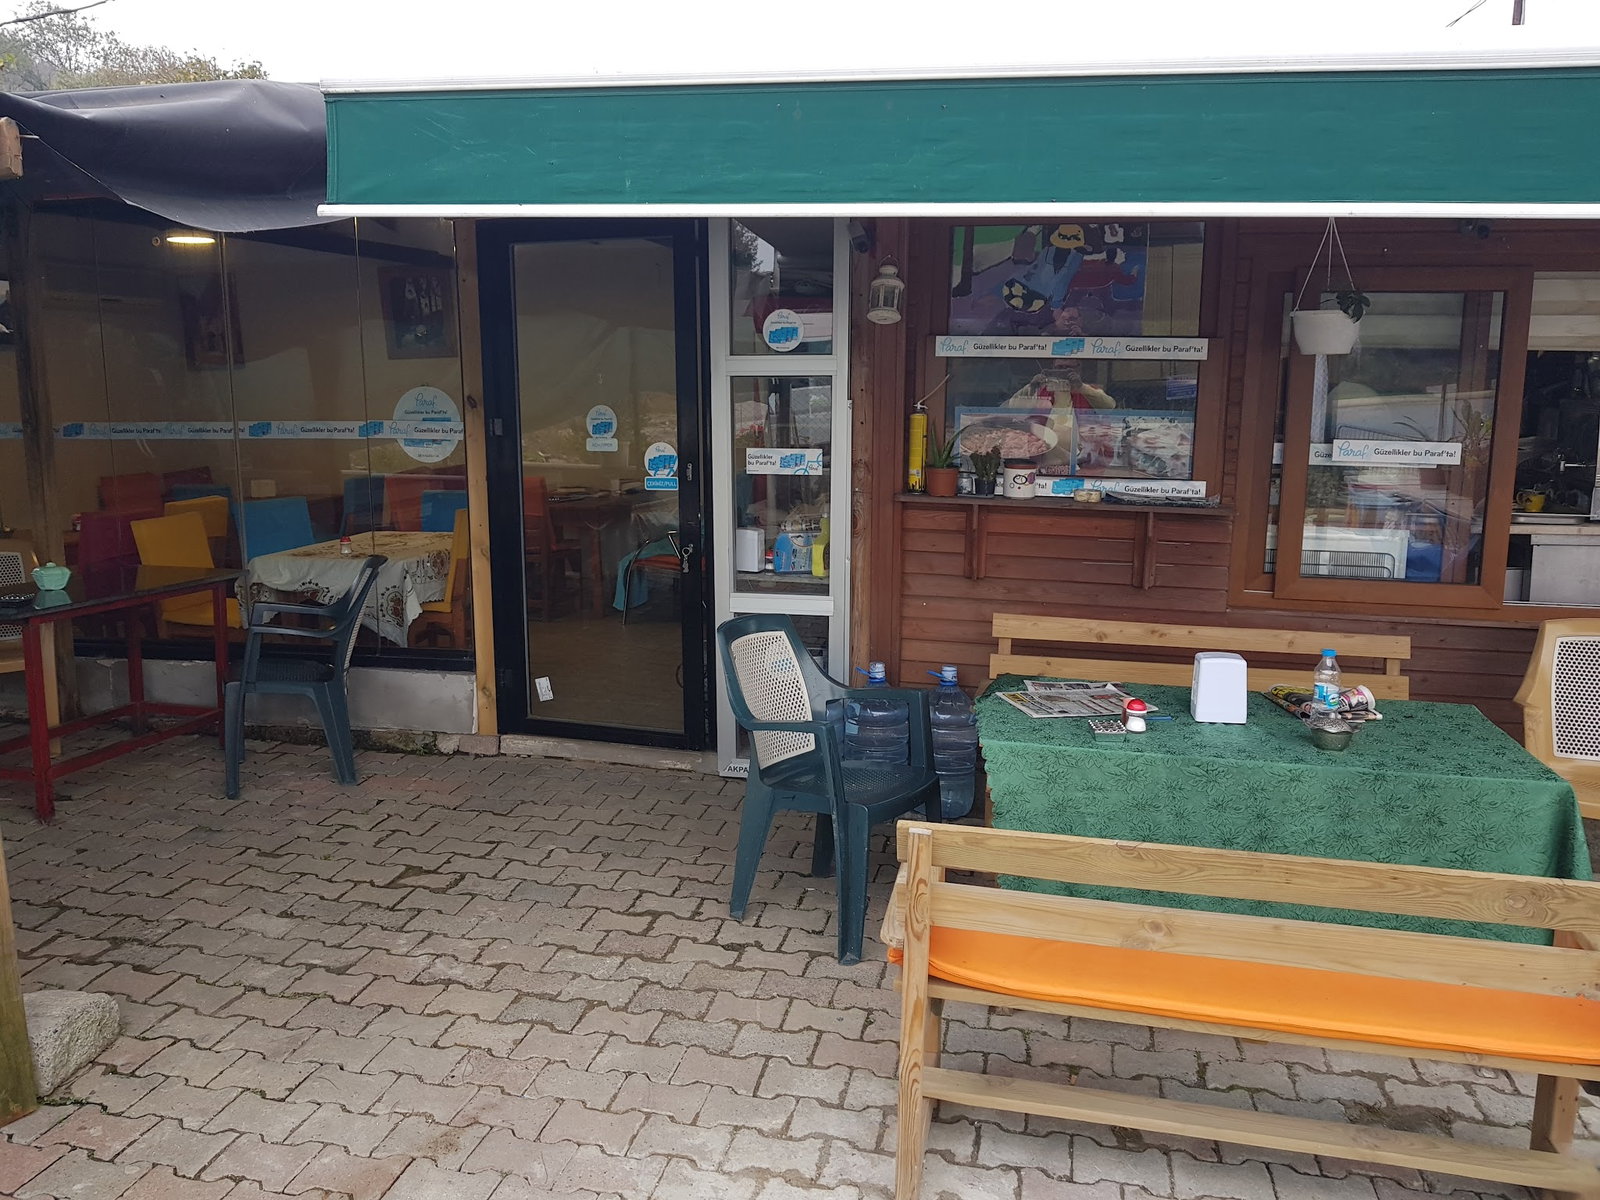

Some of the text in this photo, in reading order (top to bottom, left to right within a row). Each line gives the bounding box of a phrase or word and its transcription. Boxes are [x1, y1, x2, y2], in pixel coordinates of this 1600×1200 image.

[940, 337, 1204, 355] Paraf Güzellikler bu Paraf'ta! Paraf Güzellikler bu Paraf'ta!
[415, 393, 438, 408] Paraf
[414, 426, 441, 435] Güzellikler
[1337, 441, 1370, 457] Paraf
[1373, 447, 1412, 456] Güzellikler
[1413, 448, 1423, 457] bu
[1424, 449, 1457, 458] Paraf'ta!
[1124, 485, 1160, 494] Güzellikler
[1160, 486, 1170, 494] bu
[1171, 487, 1202, 496] Paraf'ta!
